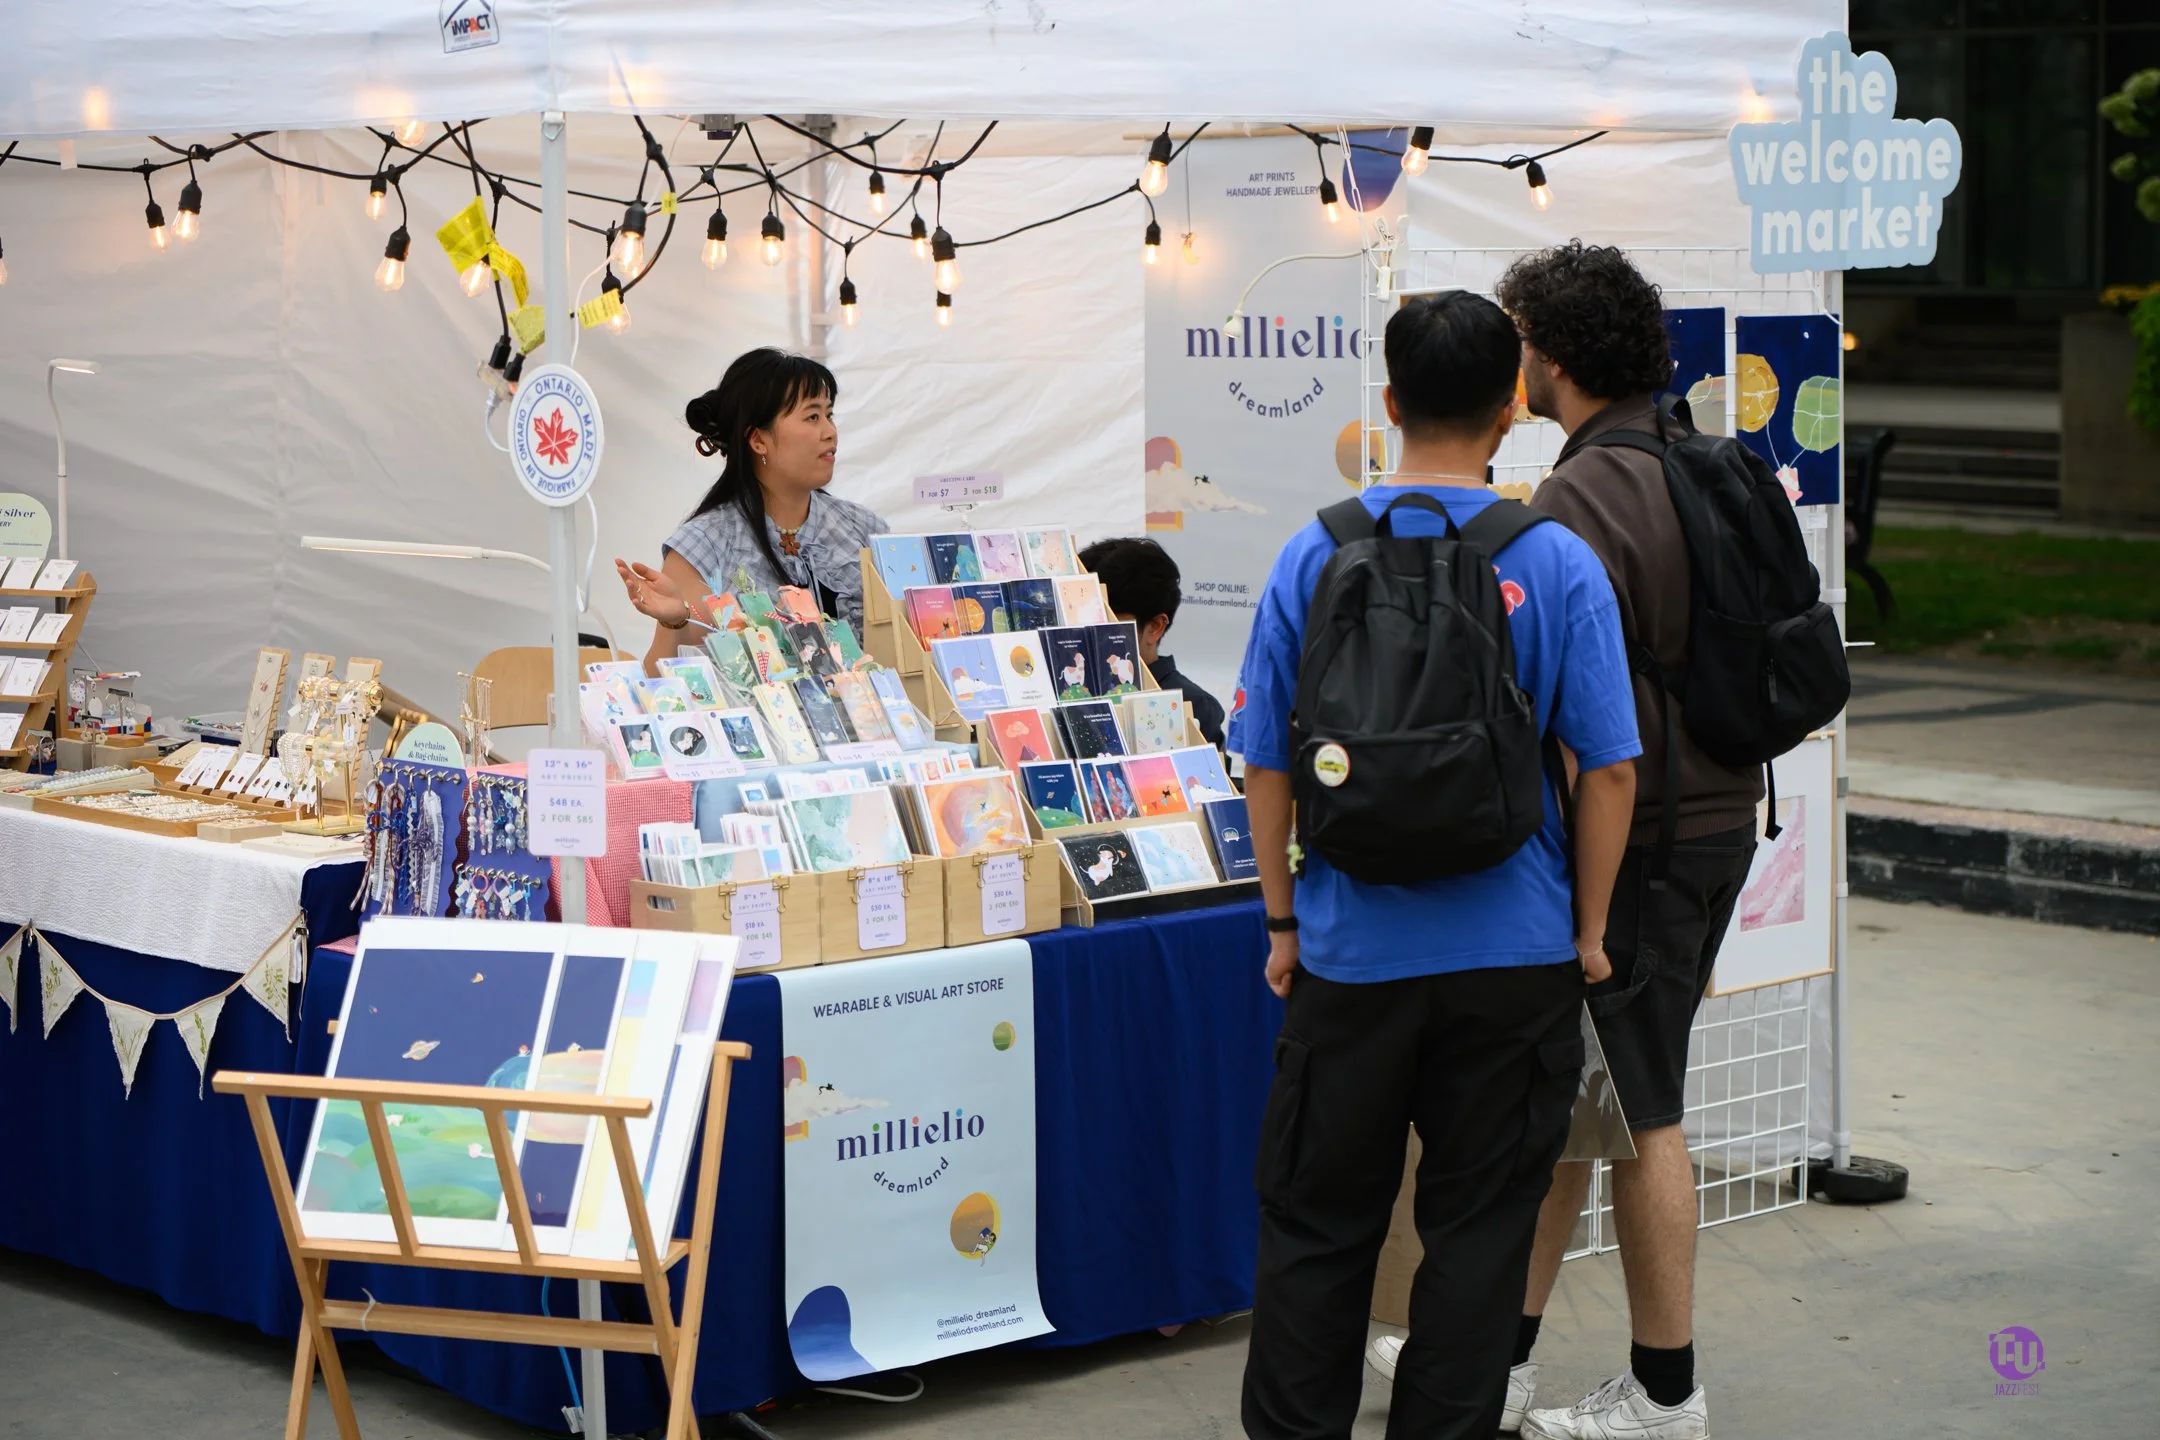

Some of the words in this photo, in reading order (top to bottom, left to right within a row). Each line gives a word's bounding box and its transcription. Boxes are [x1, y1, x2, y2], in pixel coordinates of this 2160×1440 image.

[1809, 50, 1886, 114] the
[1741, 119, 1952, 185] welcome
[1249, 173, 1264, 182] ART
[1266, 172, 1295, 182] PRINTS
[1226, 187, 1271, 197] HANDMADE
[1273, 186, 1320, 196] JEWELLERY
[1762, 186, 1933, 255] market
[1229, 377, 1324, 418] dreamland
[535, 378, 583, 407] ONTARIO
[582, 413, 594, 462] MADE
[517, 409, 527, 461] ONTARIO
[526, 465, 536, 478] EN
[921, 490, 924, 498] 1
[940, 489, 949, 498] $7
[984, 485, 997, 494] $18
[1194, 582, 1216, 591] SHOP
[1218, 583, 1249, 594] ONLINE:
[414, 740, 446, 751] keychains
[549, 798, 568, 807] $48
[552, 815, 571, 823] FOR
[870, 904, 882, 912] $30
[746, 933, 759, 941] FOR
[813, 997, 880, 1018] WEARABLE
[883, 995, 892, 1008] &
[896, 988, 938, 1005] VISUAL
[941, 984, 964, 998] ART
[967, 978, 1004, 995] STORE
[837, 1108, 985, 1161] millielio
[873, 1156, 949, 1193] dreamland
[937, 1304, 1016, 1328] @millielio_dreamland
[937, 1316, 1024, 1341] millieliodreamland.com
